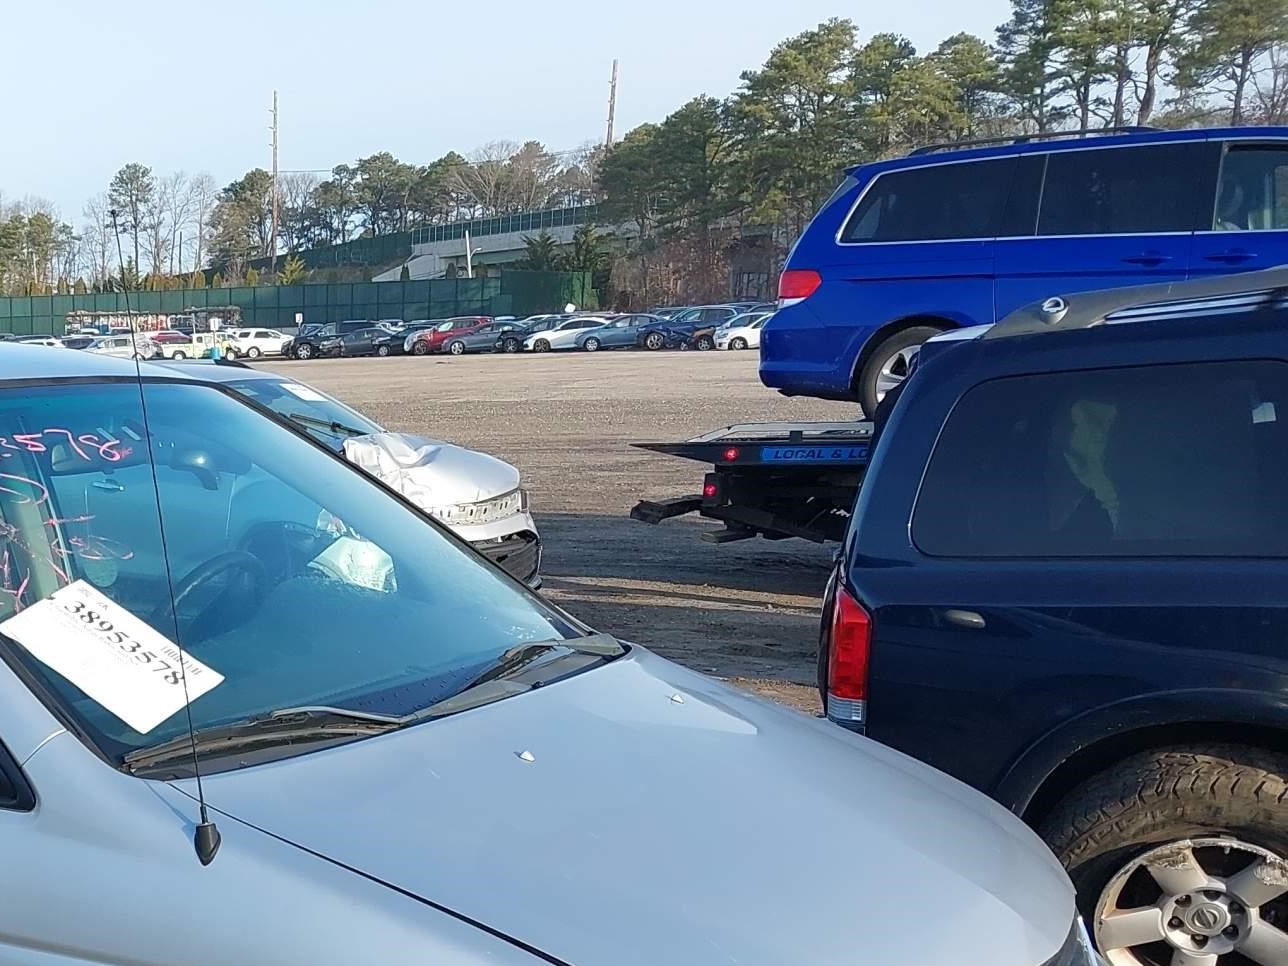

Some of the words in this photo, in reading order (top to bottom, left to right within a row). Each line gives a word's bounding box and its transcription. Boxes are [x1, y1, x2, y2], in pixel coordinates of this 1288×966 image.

[774, 448, 825, 460] LOCAL
[831, 448, 843, 459] &
[64, 600, 186, 685] 38953578
